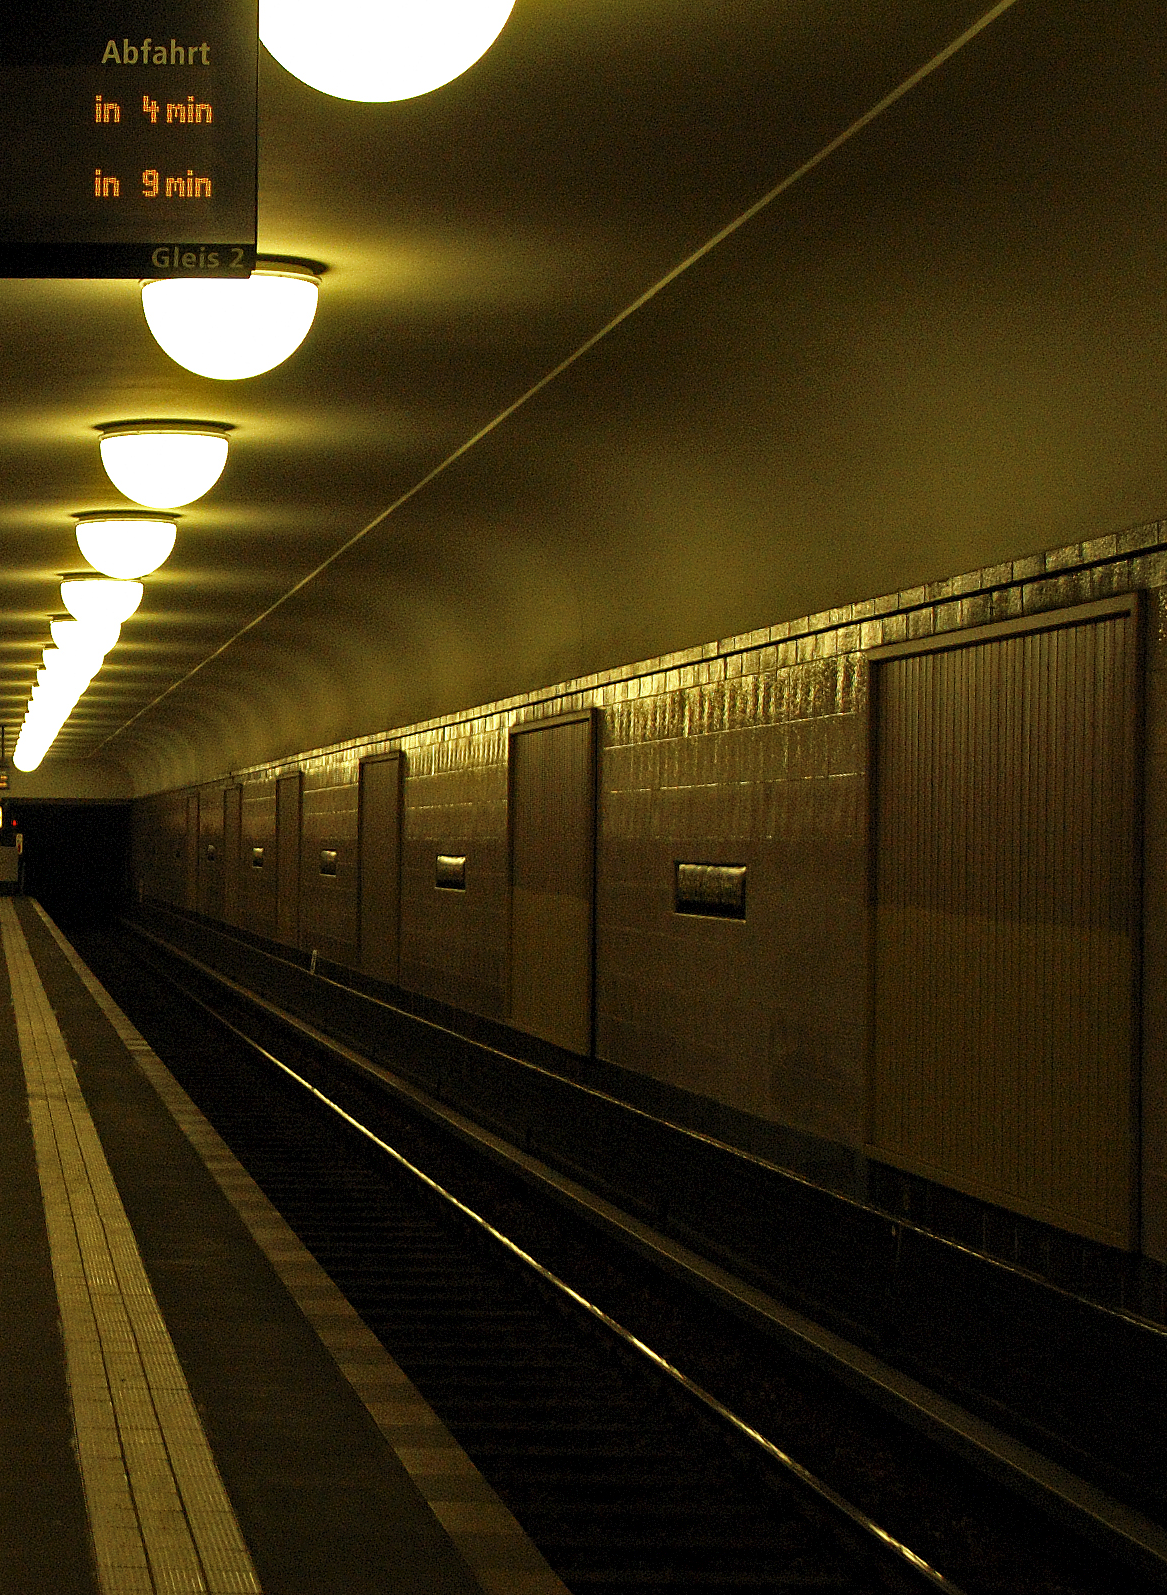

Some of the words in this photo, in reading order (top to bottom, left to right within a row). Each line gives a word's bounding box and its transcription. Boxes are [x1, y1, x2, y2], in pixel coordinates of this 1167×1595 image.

[101, 38, 211, 66] Abfahrt
[94, 95, 122, 124] in
[141, 95, 161, 124] 4
[165, 95, 214, 124] min
[94, 168, 121, 198] in
[141, 168, 161, 198] 9
[164, 168, 214, 198] min
[151, 246, 222, 271] Gleis
[227, 247, 246, 271] 2
